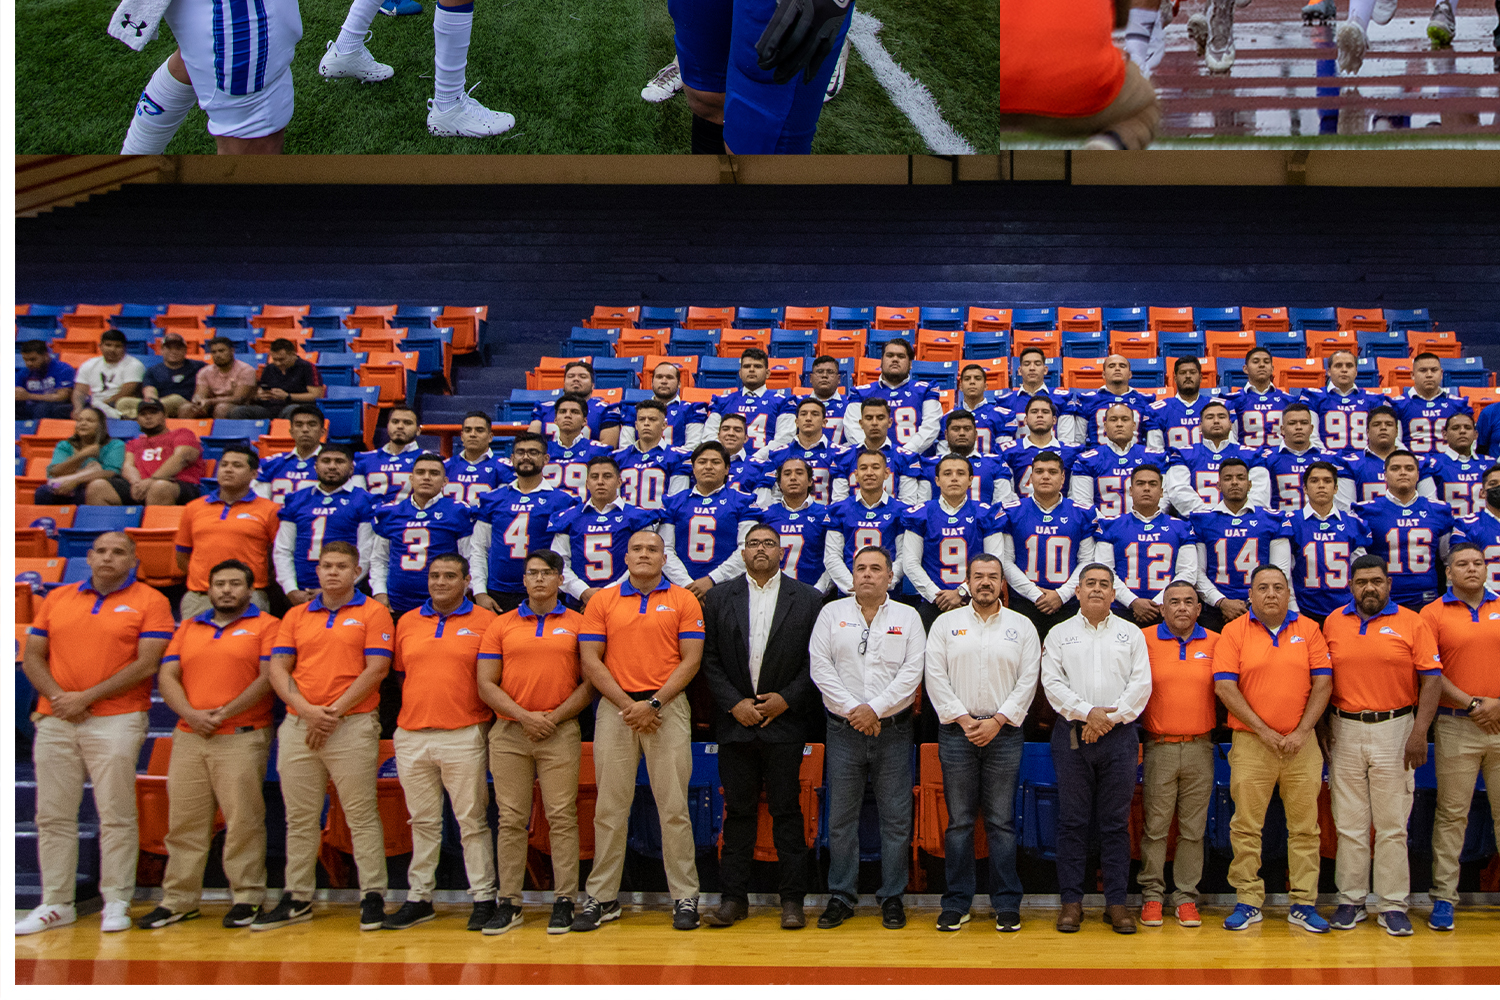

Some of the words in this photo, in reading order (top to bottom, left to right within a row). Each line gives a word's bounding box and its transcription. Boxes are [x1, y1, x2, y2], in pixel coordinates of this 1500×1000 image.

[738, 405, 758, 413] UAT
[1253, 403, 1273, 411] UAT
[1336, 404, 1357, 412] UAT
[1421, 409, 1441, 417] UAT
[1180, 418, 1200, 426] UAT
[1242, 410, 1284, 447] 93
[1323, 410, 1369, 449] 98
[379, 463, 403, 473] UAT
[286, 470, 310, 480] UAT
[457, 474, 479, 483] UAT
[1457, 473, 1479, 482] UAT
[540, 463, 588, 502] 29
[619, 468, 667, 510] 30
[312, 506, 337, 516] UAT
[510, 503, 535, 512] UAT
[693, 506, 717, 515] UAT
[405, 520, 431, 528] UAT
[857, 520, 881, 528] UAT
[1396, 518, 1420, 527] UAT
[587, 524, 612, 533] UAT
[780, 524, 804, 533] UAT
[941, 526, 965, 536] UAT
[1035, 525, 1059, 535] UAT
[1224, 528, 1248, 538] UAT
[307, 515, 327, 561] 1
[503, 511, 530, 559] 4
[688, 515, 716, 563] 6
[1137, 532, 1161, 542] UAT
[1312, 531, 1337, 541] UAT
[400, 527, 430, 571] 3
[1385, 527, 1433, 575] 16
[583, 533, 614, 581] 5
[939, 536, 968, 584] 9
[1024, 534, 1072, 584] 10
[1214, 537, 1260, 586] 14
[1123, 541, 1174, 591] 12
[1302, 541, 1350, 589] 15
[951, 628, 968, 636] UAT
